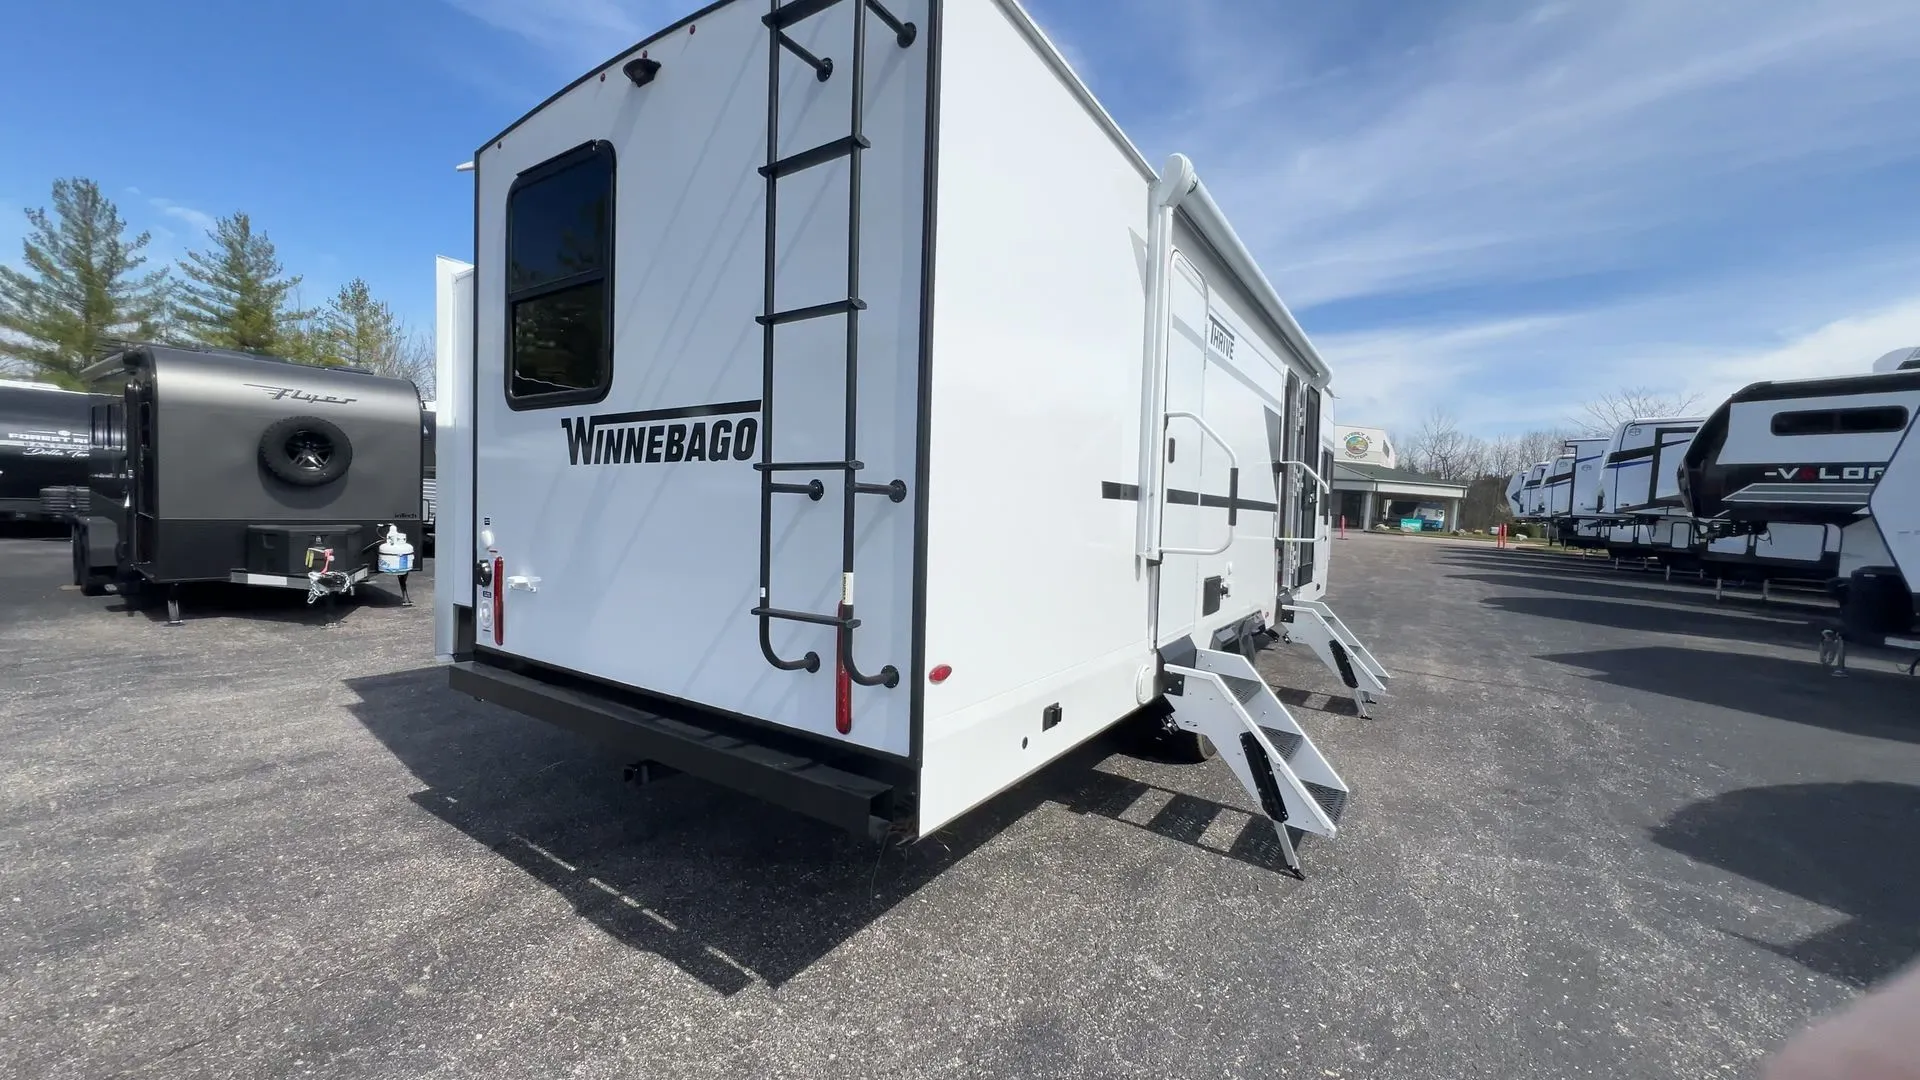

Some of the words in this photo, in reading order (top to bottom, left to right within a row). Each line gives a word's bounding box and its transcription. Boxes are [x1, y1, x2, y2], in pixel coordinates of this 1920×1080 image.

[1208, 313, 1235, 360] THRIVE
[243, 384, 358, 404] Flyer
[8, 432, 71, 443] FOREST
